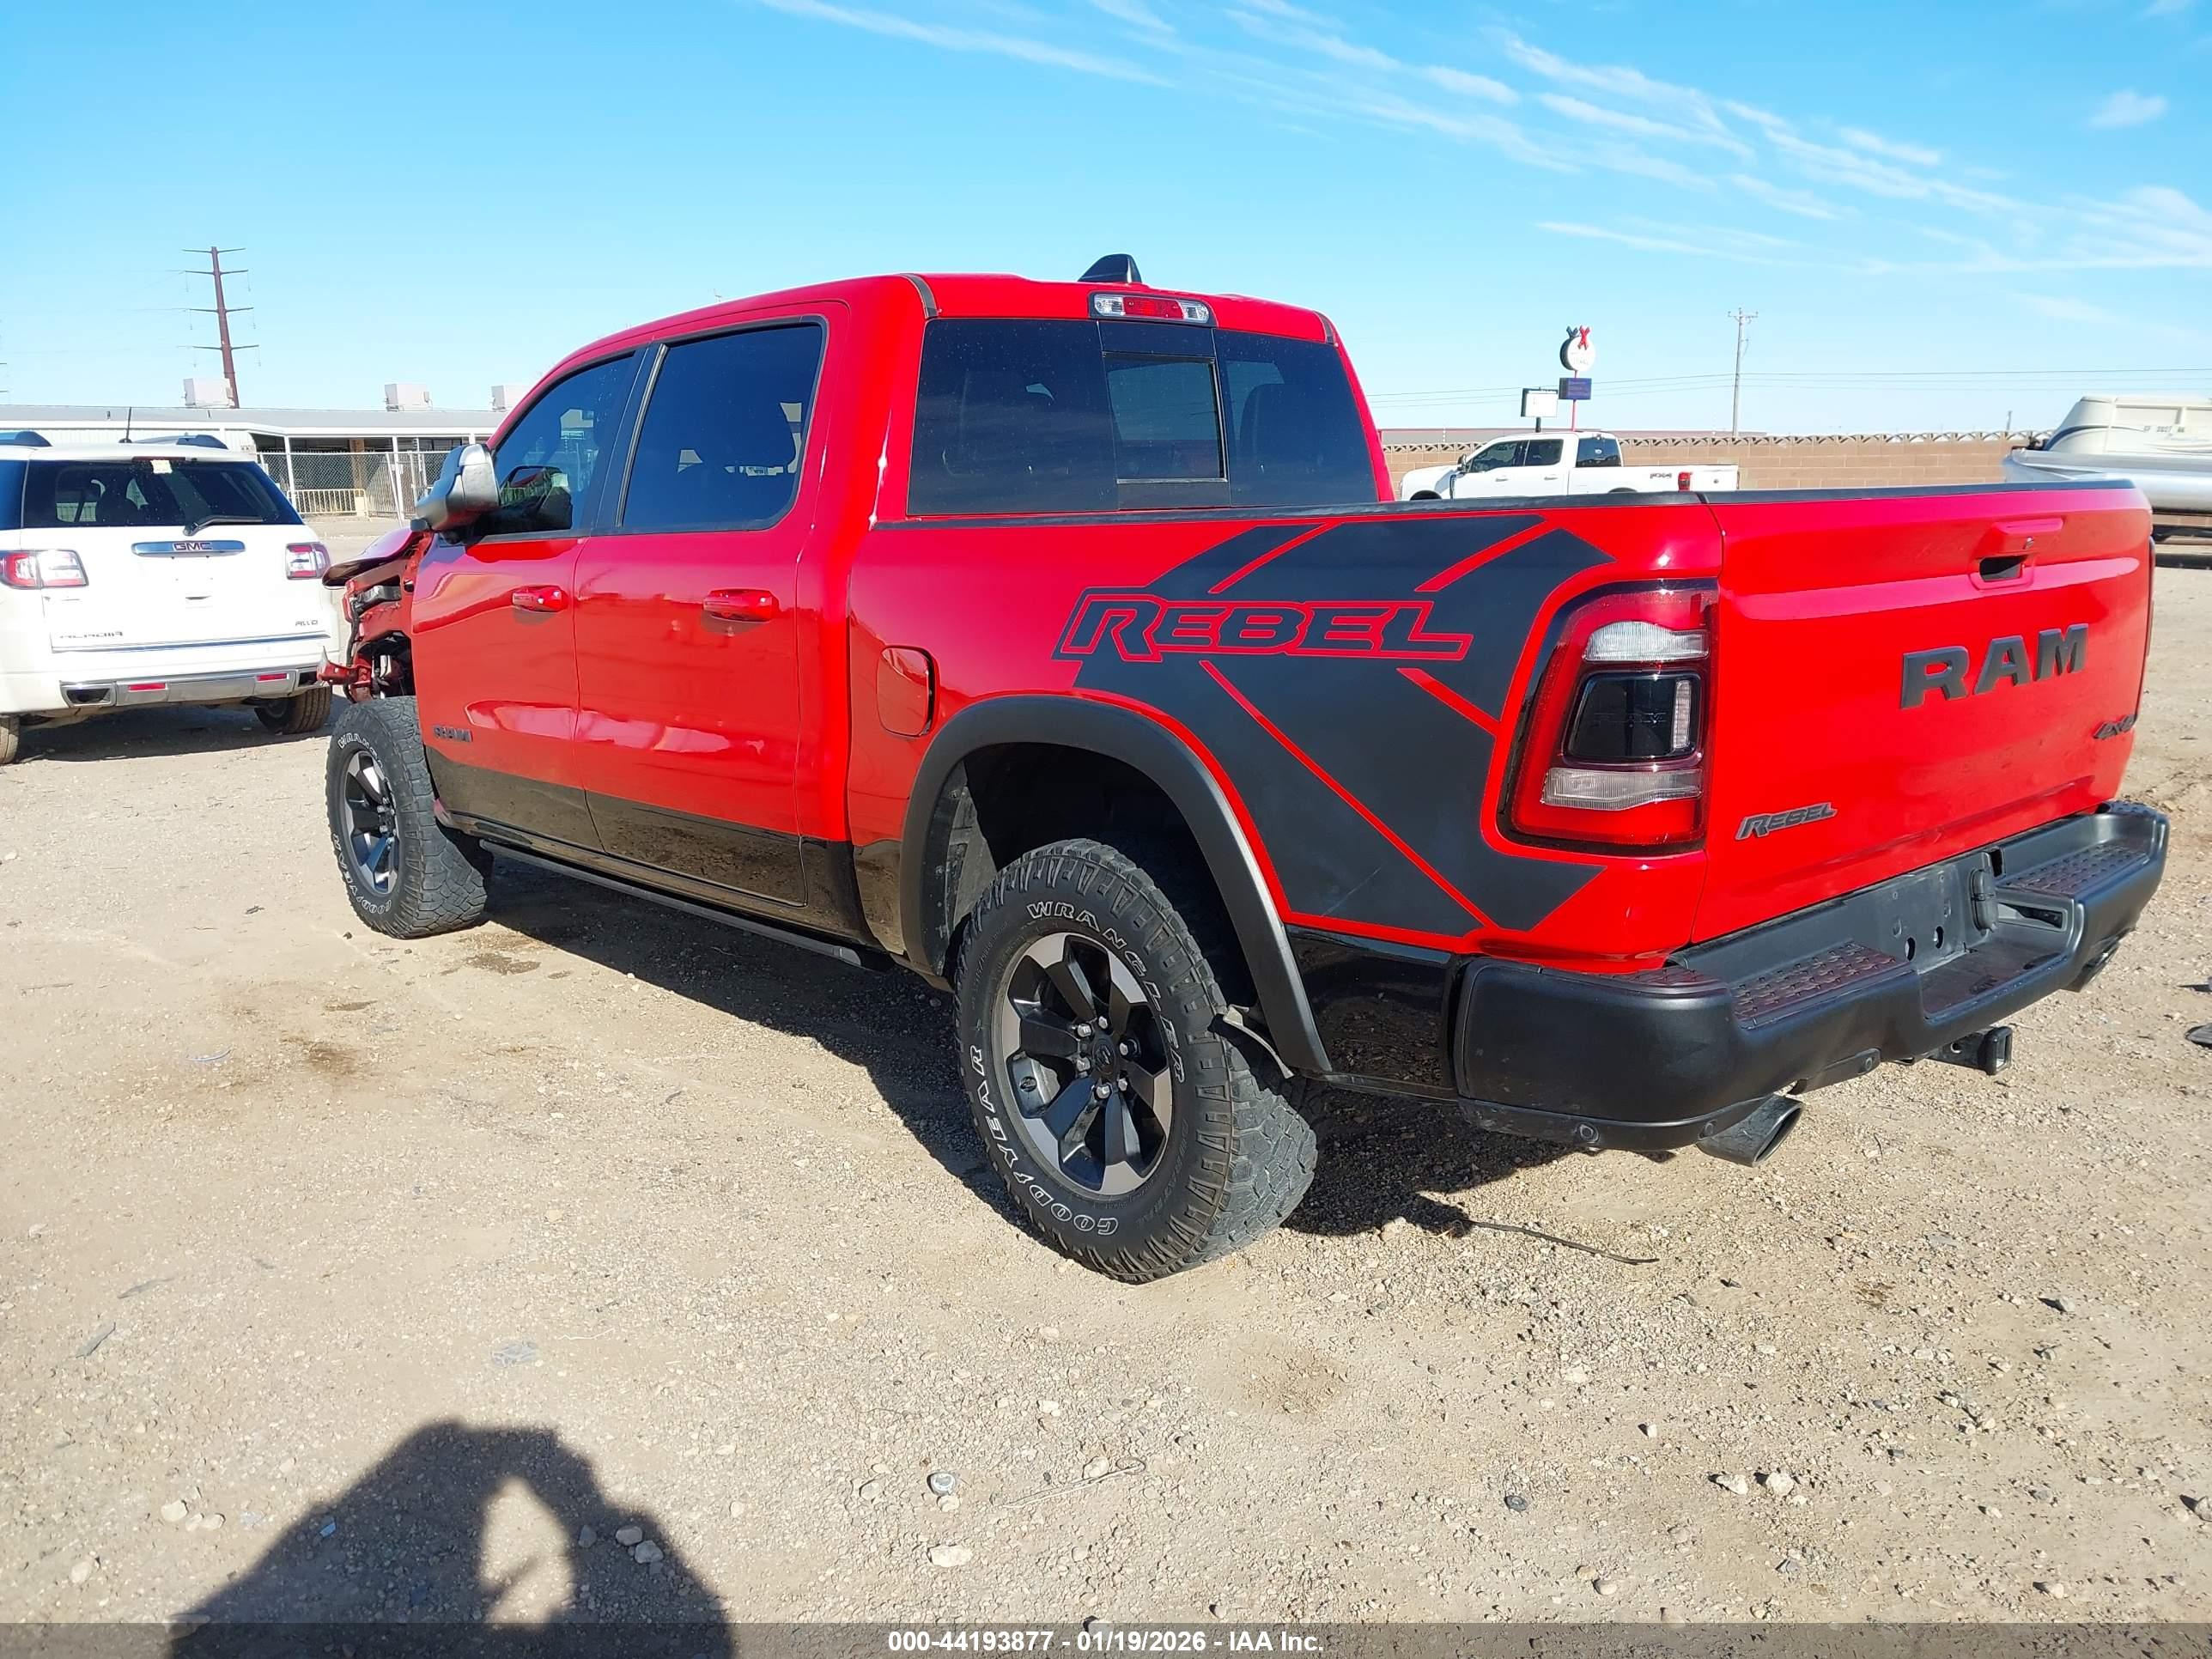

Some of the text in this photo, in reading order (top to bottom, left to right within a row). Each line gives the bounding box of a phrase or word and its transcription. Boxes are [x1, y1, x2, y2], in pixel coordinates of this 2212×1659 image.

[173, 542, 213, 550] GMC
[1060, 594, 1474, 662] REBEL
[1899, 623, 2089, 709] RAM
[1735, 802, 1838, 841] REBEL
[1027, 901, 1186, 1084] WRANGLER
[969, 1044, 1119, 1237] GOODYEAR
